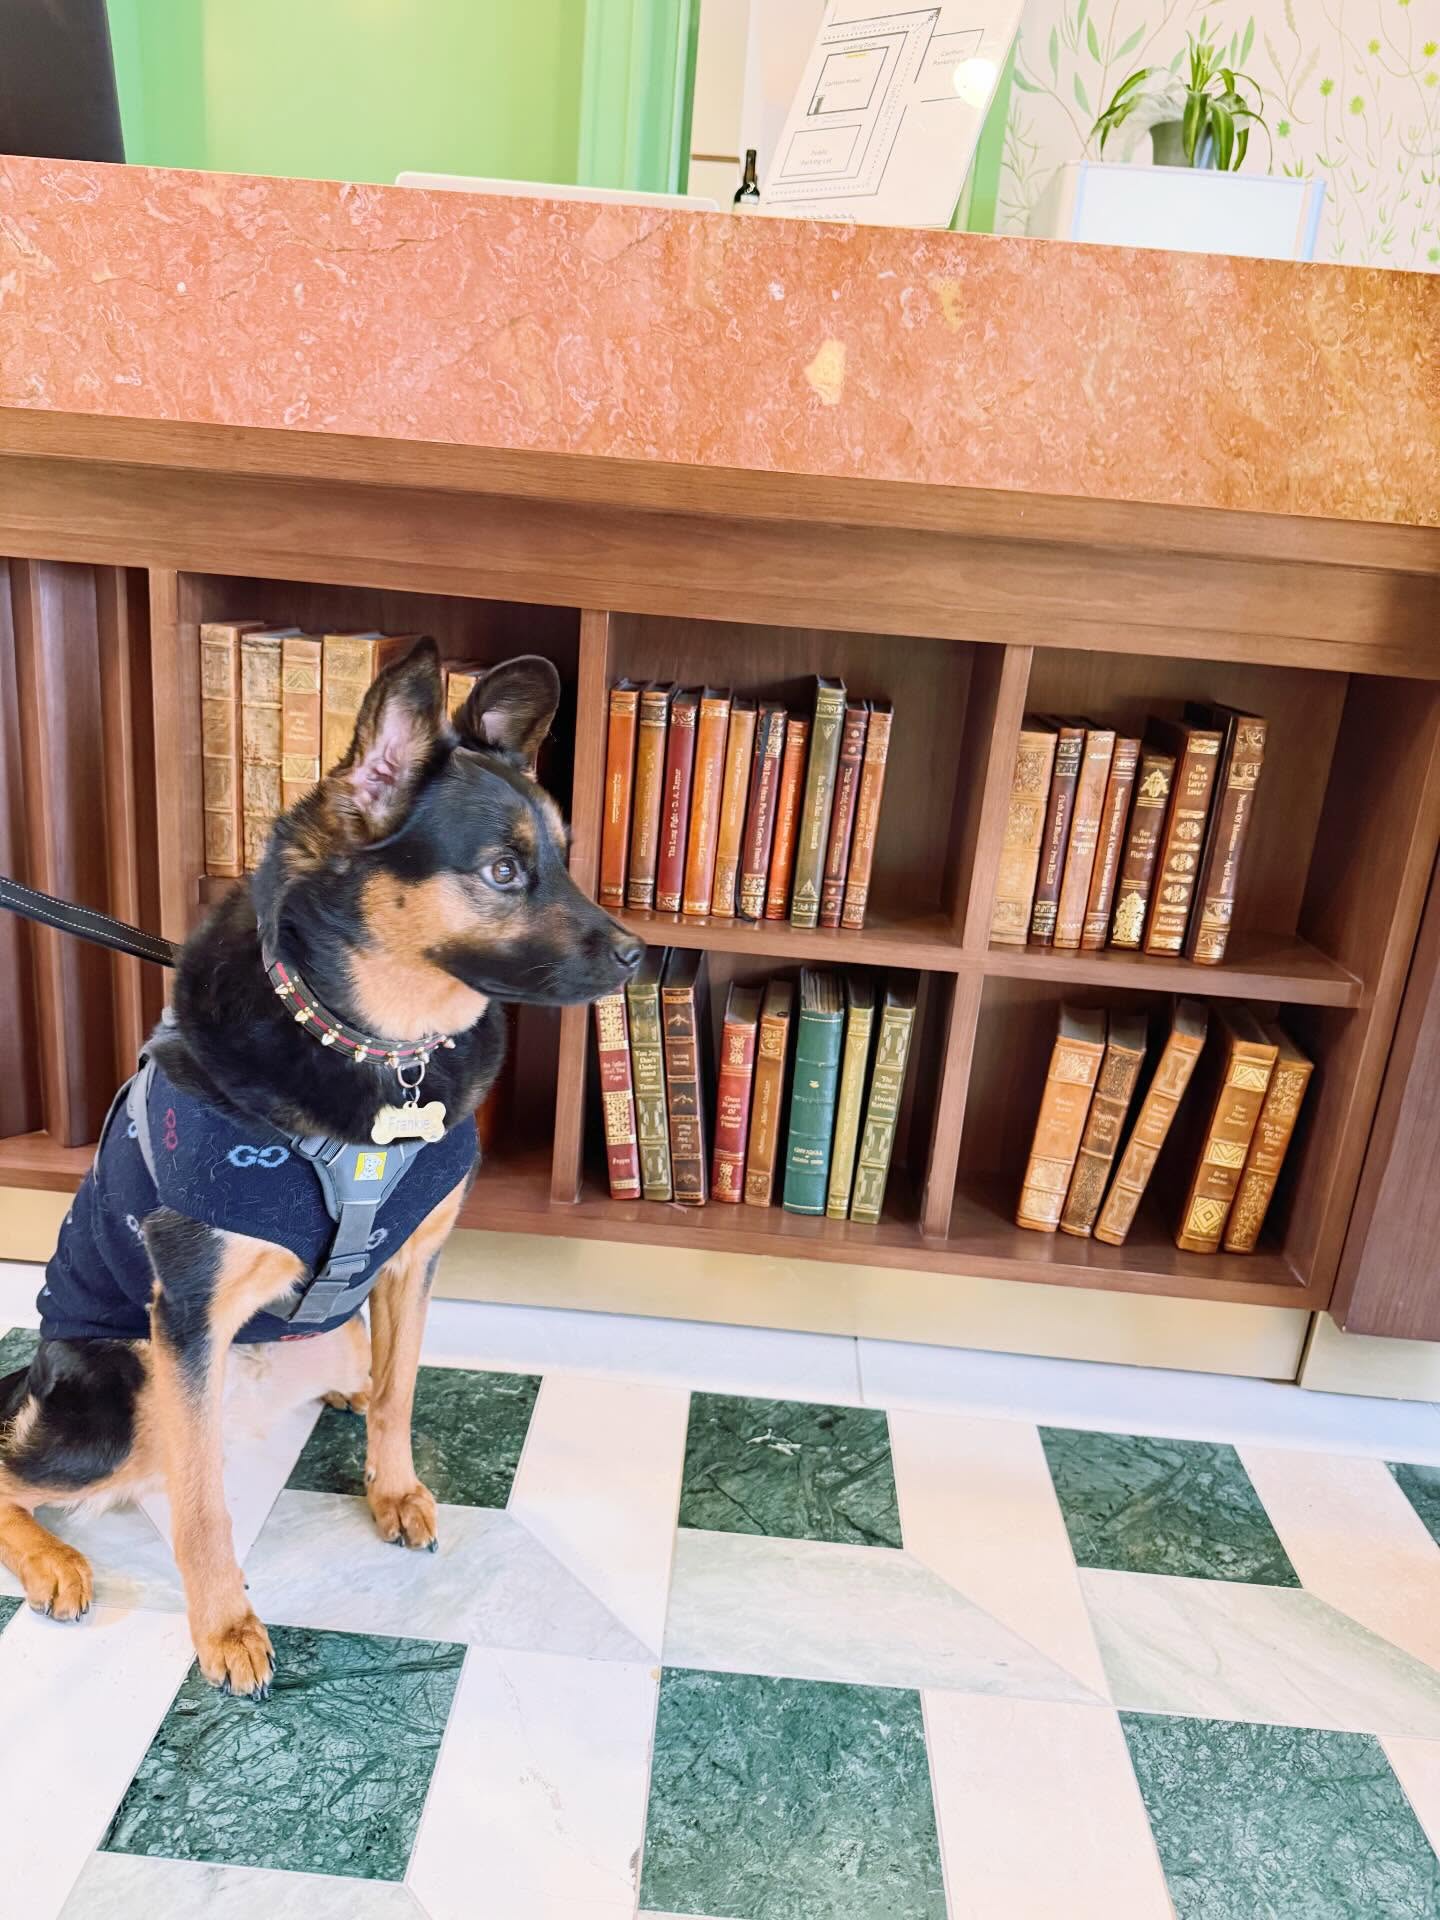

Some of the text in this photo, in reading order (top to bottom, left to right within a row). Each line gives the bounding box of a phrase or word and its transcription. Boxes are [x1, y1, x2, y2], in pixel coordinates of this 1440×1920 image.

[669, 811, 679, 828] Fight
[668, 828, 678, 845] Long
[667, 844, 677, 858] The
[388, 1116, 432, 1130] Frankie
